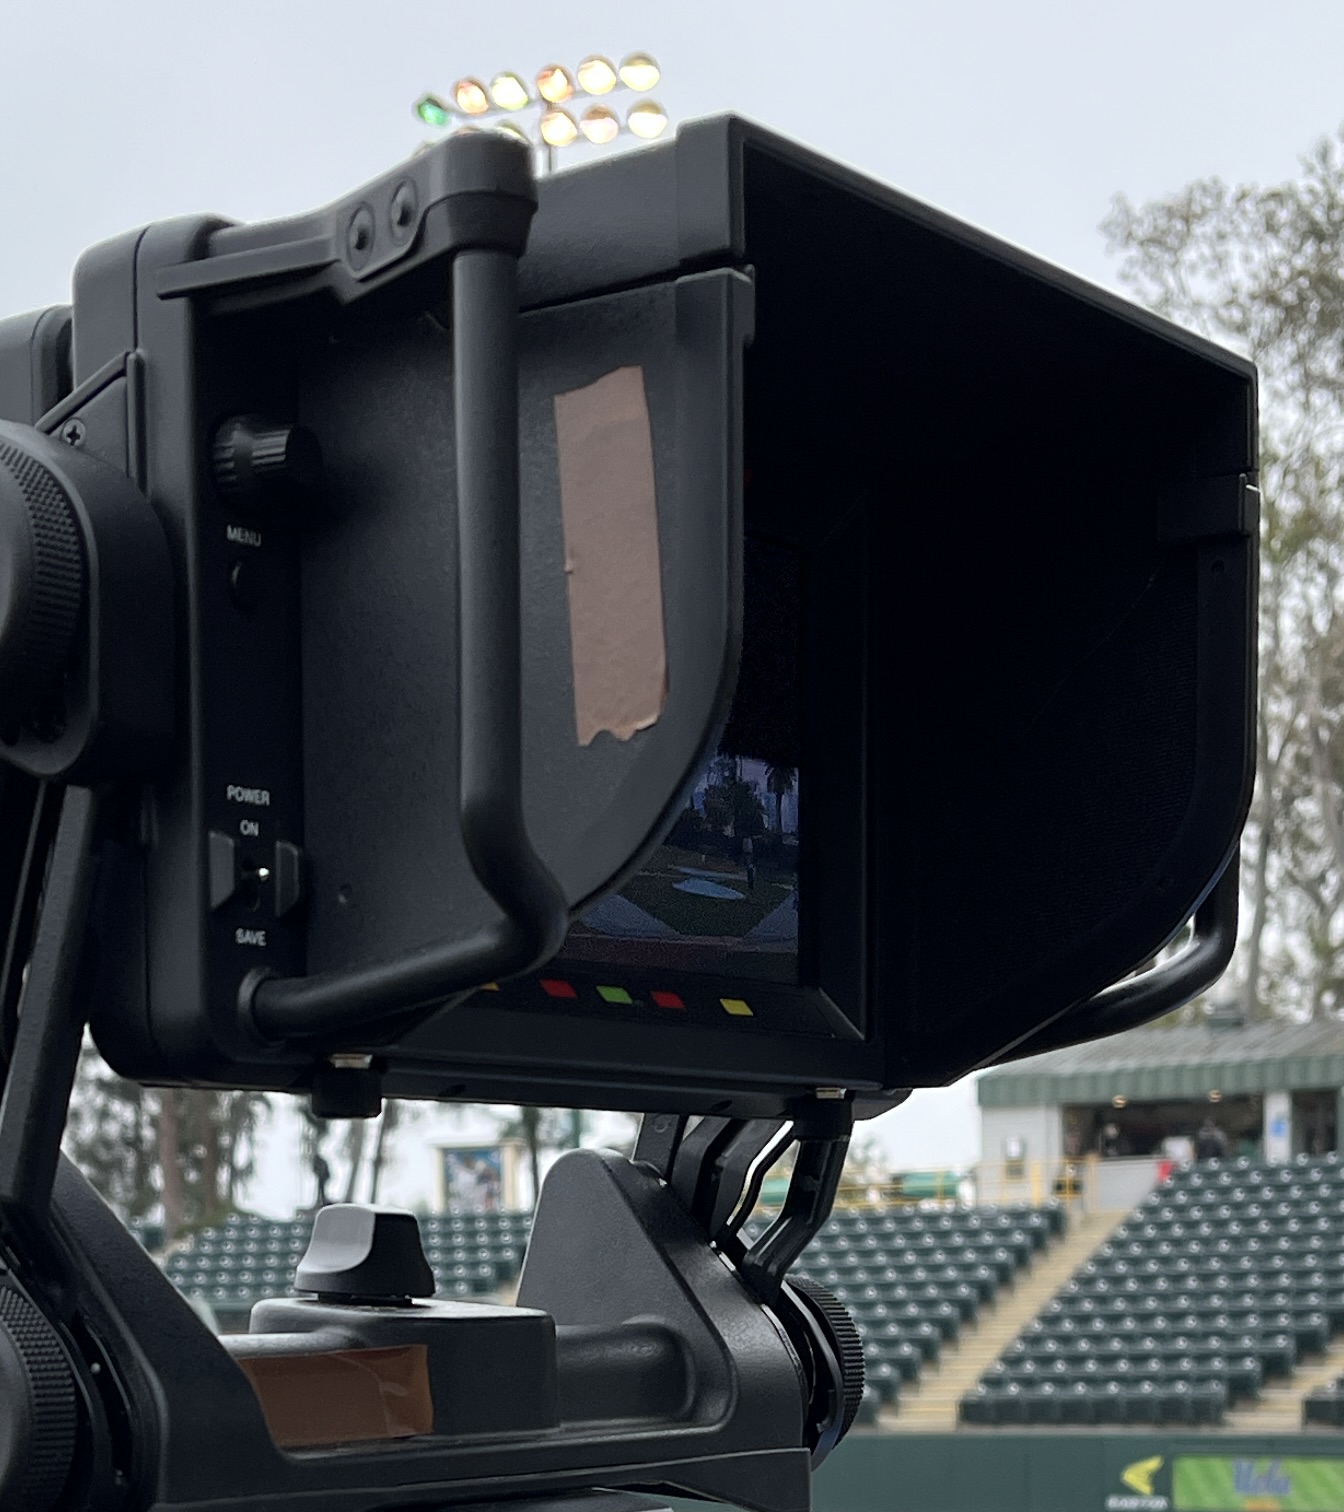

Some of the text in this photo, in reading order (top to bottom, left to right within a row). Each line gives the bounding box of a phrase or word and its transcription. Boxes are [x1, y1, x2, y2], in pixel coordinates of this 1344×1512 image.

[227, 524, 261, 547] MENU
[226, 784, 270, 806] POWER
[240, 819, 259, 837] ON
[235, 928, 267, 947] SAVE
